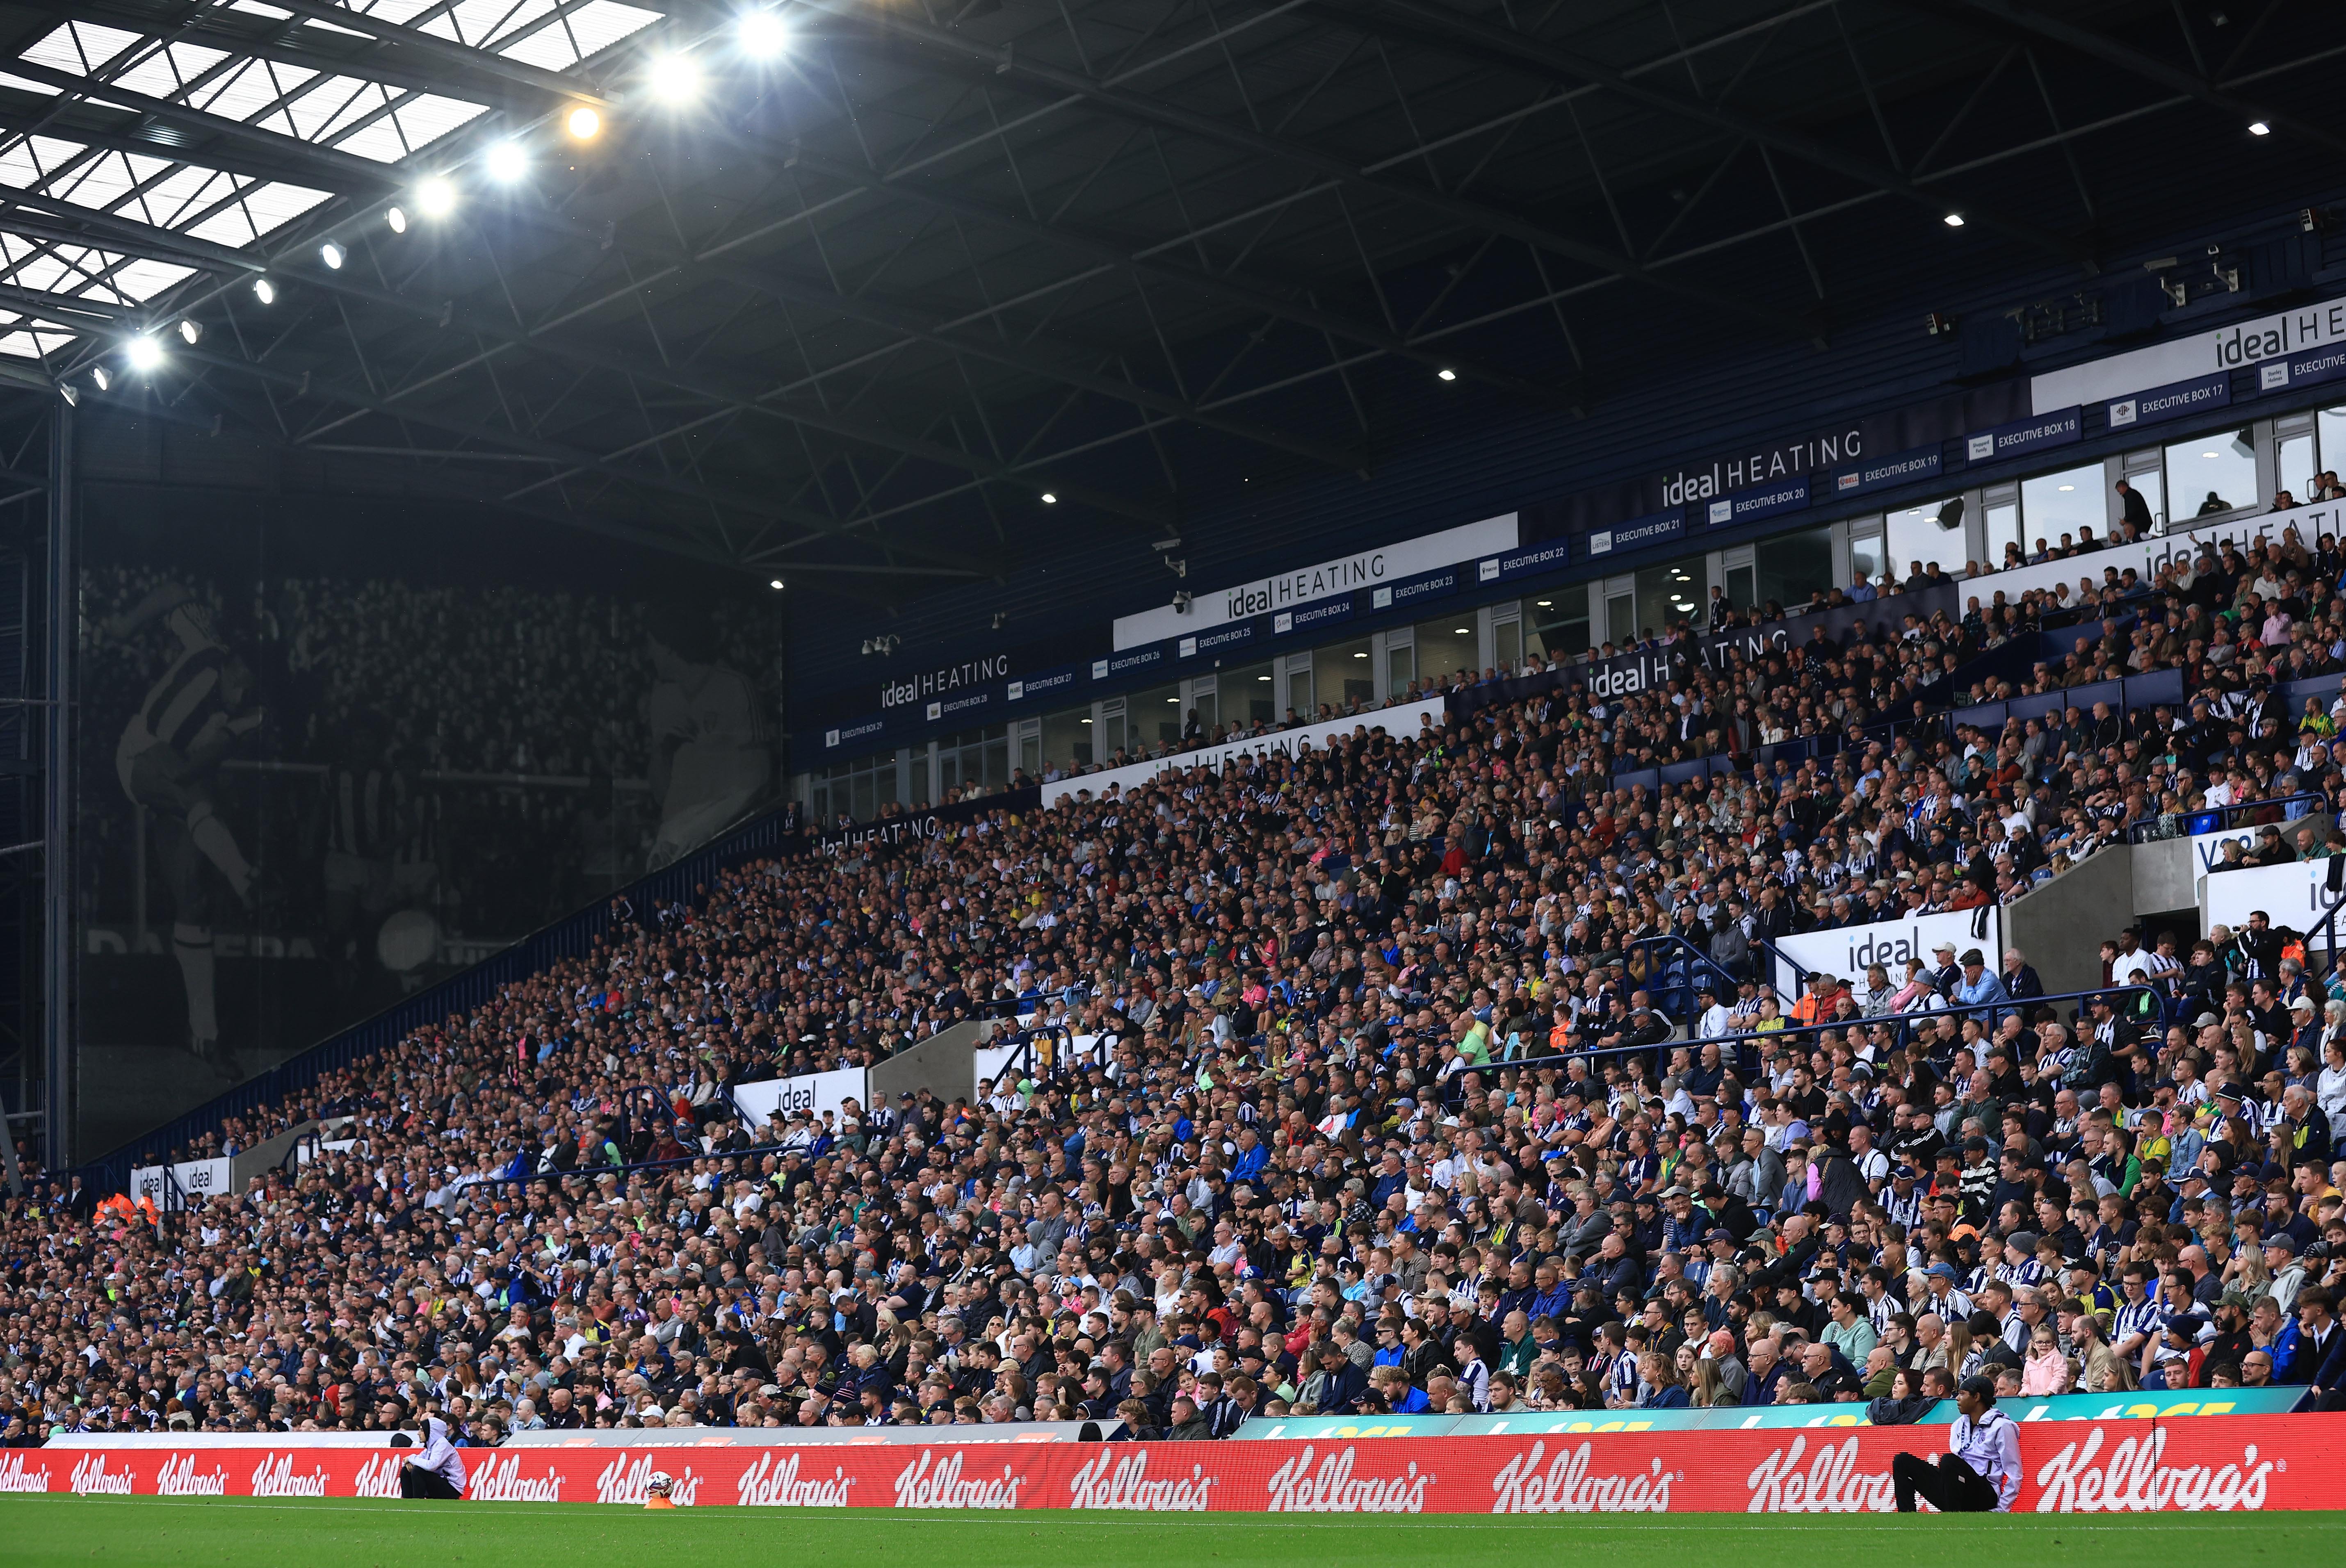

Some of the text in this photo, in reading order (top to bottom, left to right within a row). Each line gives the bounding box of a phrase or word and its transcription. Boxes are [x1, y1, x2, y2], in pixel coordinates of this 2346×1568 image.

[2216, 317, 2288, 367] ideal
[2295, 353, 2346, 376] EXECUTIVE
[2143, 384, 2223, 413] EXECUTIVE BOX 17
[1999, 419, 2075, 447] EXECUTIVE BOX 18
[1663, 430, 1861, 507] ideal HEATING
[1865, 455, 1938, 482] EXECUTIVE BOX 19
[1736, 495, 1775, 512] EXECUTIVE
[1778, 491, 1793, 503] BOX
[1795, 488, 1804, 499] 20
[1616, 519, 1680, 543] EXECUTIVE BOX 21
[1593, 541, 1610, 549] LISTERS
[1504, 547, 1563, 570] EXECUTIVE BOX 22
[1228, 554, 1384, 618] ideal HEATING
[1396, 576, 1453, 598] EXECUTIVE BOX 23
[1296, 602, 1349, 624] EXECUTIVE BOX 24
[1200, 627, 1251, 648] EXECUTIVE BOX 25
[1111, 656, 1140, 670] EXECUTIVE
[1141, 652, 1152, 662] BOX
[1153, 651, 1160, 659] 26
[882, 655, 1007, 708] ideal HEATING
[1026, 673, 1071, 691] EXECUTIVE BOX 27
[1589, 656, 1645, 697] ideal
[944, 699, 969, 712] EXECUTIVE
[970, 696, 981, 706] BOX
[842, 726, 865, 738] EXECUTIVE
[866, 724, 876, 732] BOX
[1849, 926, 1918, 972] ideal
[779, 1080, 815, 1111] ideal
[140, 1171, 162, 1194] ideal
[189, 1165, 212, 1188] ideal
